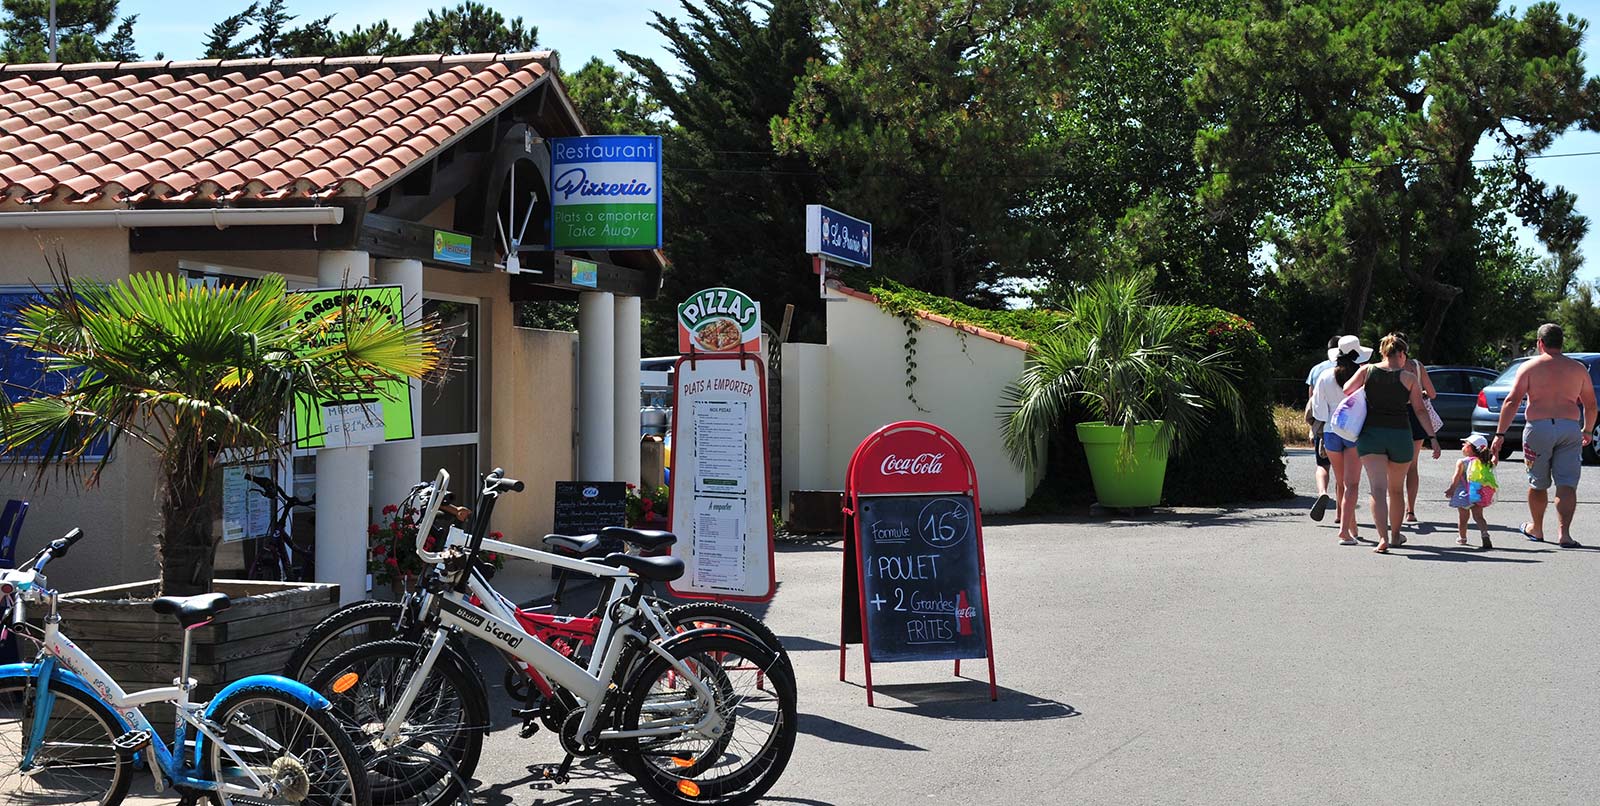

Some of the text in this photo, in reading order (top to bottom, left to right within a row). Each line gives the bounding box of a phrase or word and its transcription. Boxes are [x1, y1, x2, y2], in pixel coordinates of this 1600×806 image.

[556, 143, 654, 160] Restaurant
[555, 168, 652, 200] Pizzeria
[555, 211, 580, 223] Plats
[598, 211, 656, 223] emporter
[567, 224, 640, 238] Take Away
[683, 291, 755, 324] PIZZAS
[684, 379, 754, 397] PLATS A EMPORTER
[880, 453, 944, 476] Coca-Cola
[871, 520, 911, 541] Formule
[865, 554, 940, 580] 1 POULET
[893, 587, 907, 611] 2
[910, 590, 956, 615] Grandes
[484, 620, 524, 649] b'cool
